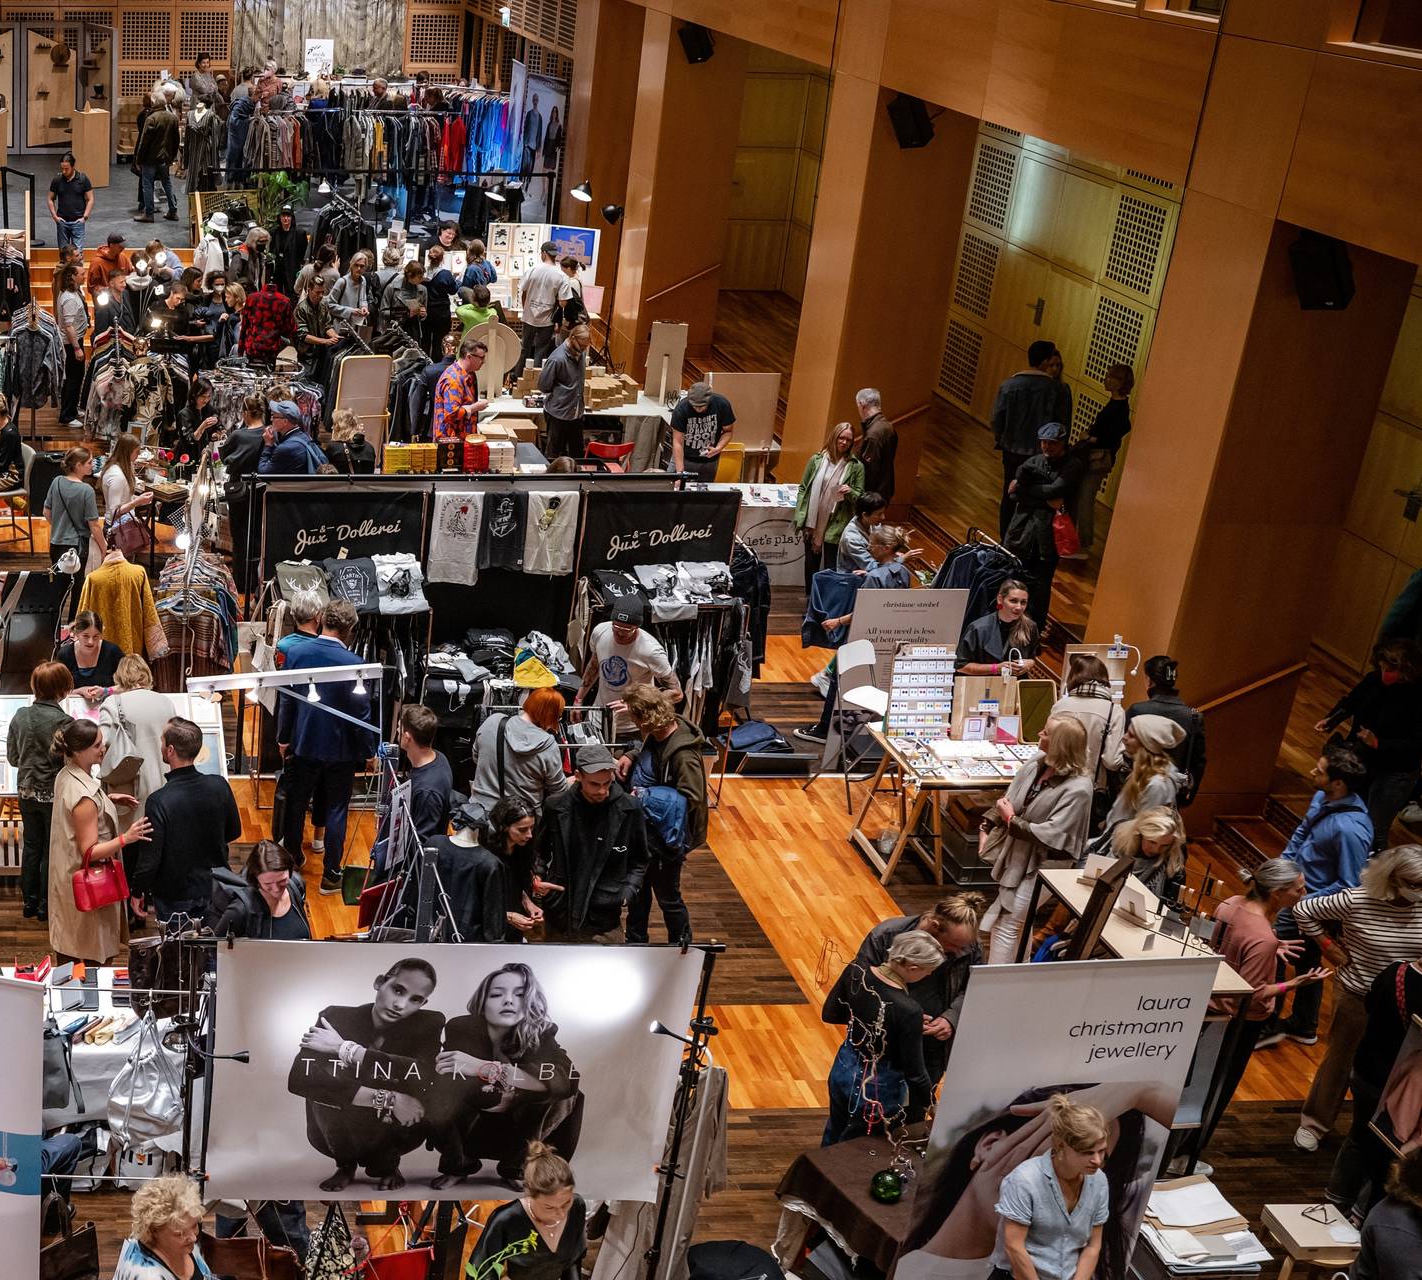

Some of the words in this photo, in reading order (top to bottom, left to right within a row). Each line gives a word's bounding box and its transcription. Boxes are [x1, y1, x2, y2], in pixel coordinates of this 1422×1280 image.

[294, 529, 328, 555] Jux
[336, 519, 401, 540] Dollerei
[607, 535, 641, 560] Jux
[649, 524, 713, 546] Dollerei
[746, 534, 772, 547] let's
[773, 534, 802, 547] play
[879, 629, 892, 637] you
[1138, 995, 1191, 1011] laura
[1069, 1020, 1184, 1038] christmann
[1085, 1042, 1177, 1063] jewellery
